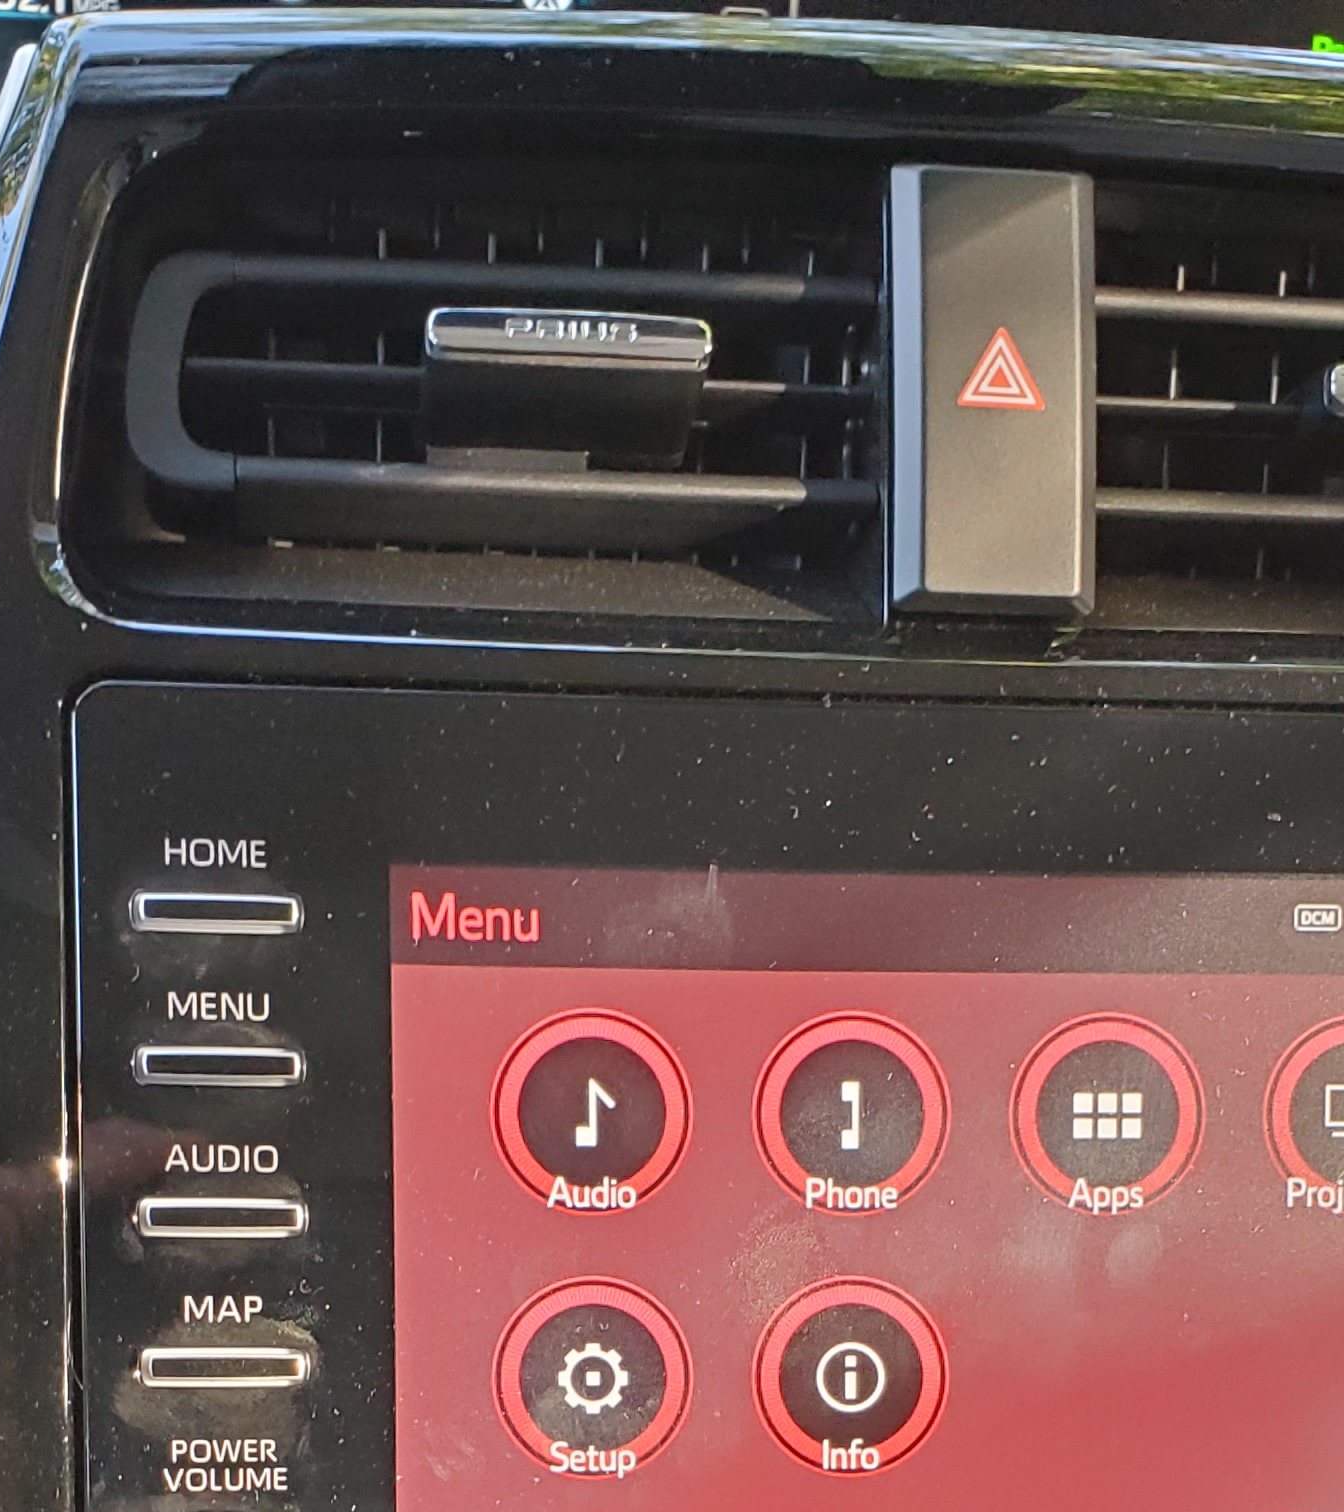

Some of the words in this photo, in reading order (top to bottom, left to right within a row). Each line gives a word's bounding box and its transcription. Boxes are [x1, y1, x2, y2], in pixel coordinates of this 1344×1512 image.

[164, 838, 267, 868] HOME
[410, 891, 540, 942] Menu
[1300, 910, 1336, 926] DCM
[167, 992, 271, 1021] MENU
[164, 1144, 279, 1174] AUDIO
[547, 1177, 637, 1211] Audio
[805, 1178, 898, 1210] Phone
[1068, 1178, 1143, 1215] Apps
[183, 1295, 263, 1324] MAP
[170, 1439, 277, 1463] POWER
[549, 1442, 636, 1477] Setup
[821, 1439, 880, 1471] Info
[163, 1467, 288, 1492] VOLUME
